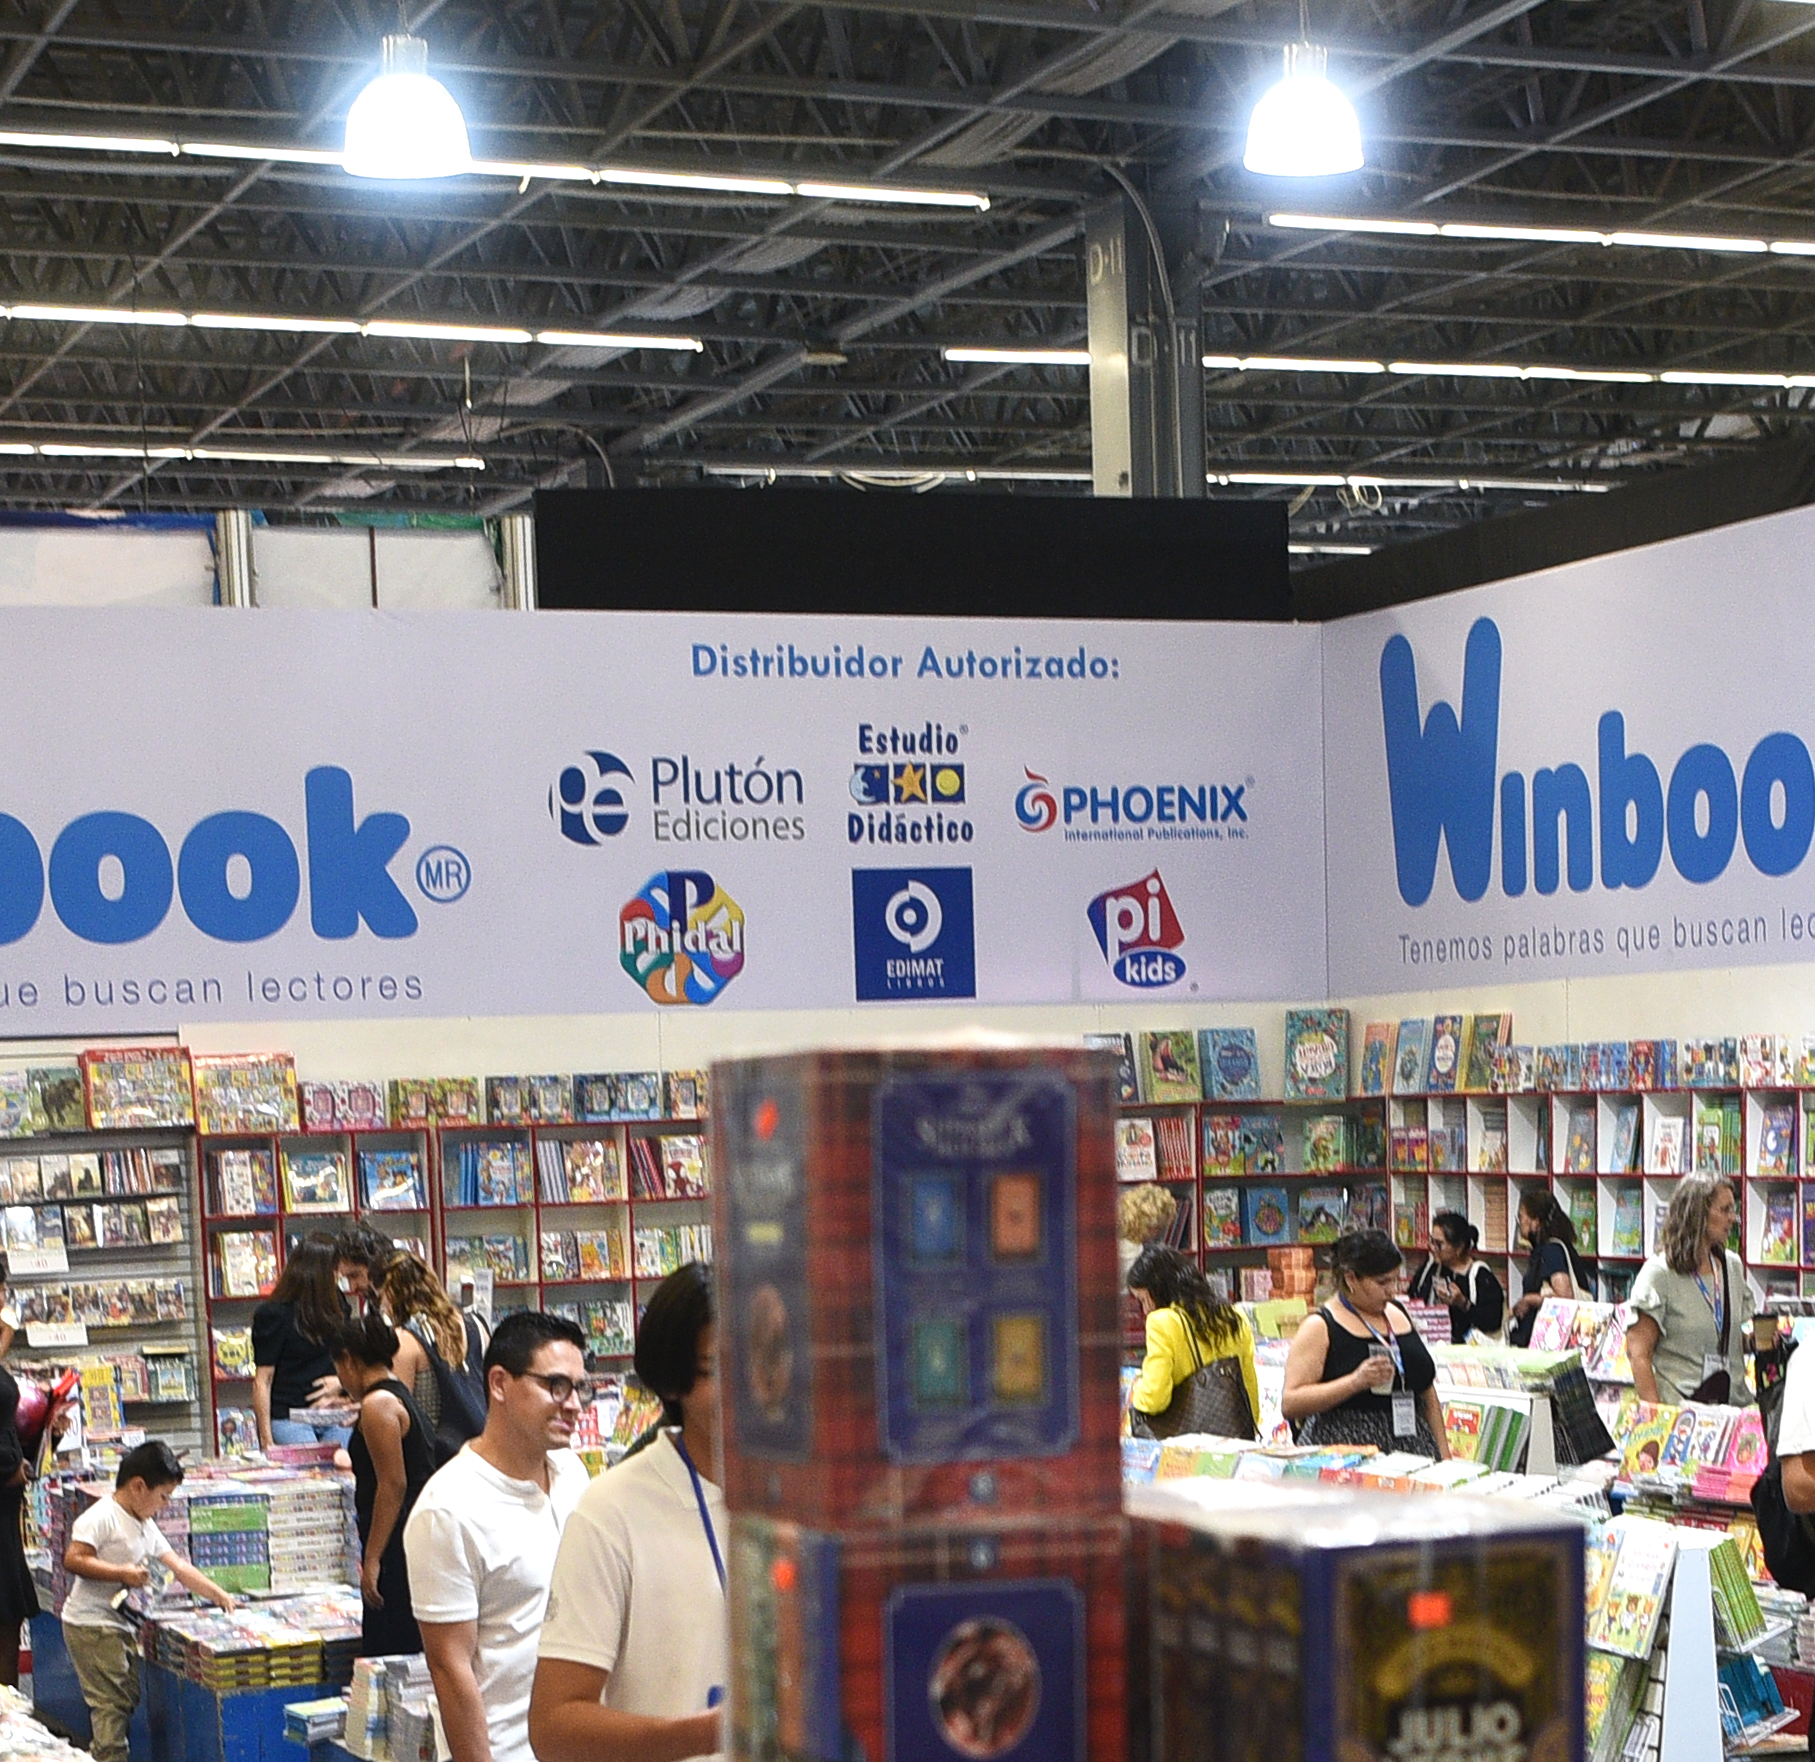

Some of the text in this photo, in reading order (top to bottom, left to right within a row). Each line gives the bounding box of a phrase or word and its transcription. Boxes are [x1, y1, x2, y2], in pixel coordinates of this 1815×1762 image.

[691, 642, 1120, 682] Distribuidor Autorizado:
[857, 722, 959, 756] Estudio
[652, 754, 803, 806] Plutón
[1063, 783, 1249, 825] PHOENIX
[653, 811, 806, 843] Ediciones
[848, 812, 974, 845] Didáctico
[1064, 828, 1249, 842] International Publications, Inc.
[425, 857, 463, 891] MR
[623, 919, 742, 955] Phidal
[1108, 879, 1165, 964] pi
[1399, 932, 1494, 964] Tenemos
[1503, 926, 1606, 965] palabras
[1616, 925, 1661, 956] que
[1674, 908, 1768, 949] buscan
[886, 958, 944, 979] EDIMAT
[887, 978, 945, 989] LIBROS
[1126, 959, 1178, 984] kids
[63, 970, 224, 1009] buscan
[246, 967, 424, 1004] lectores
[1390, 1702, 1522, 1759] JULIO
